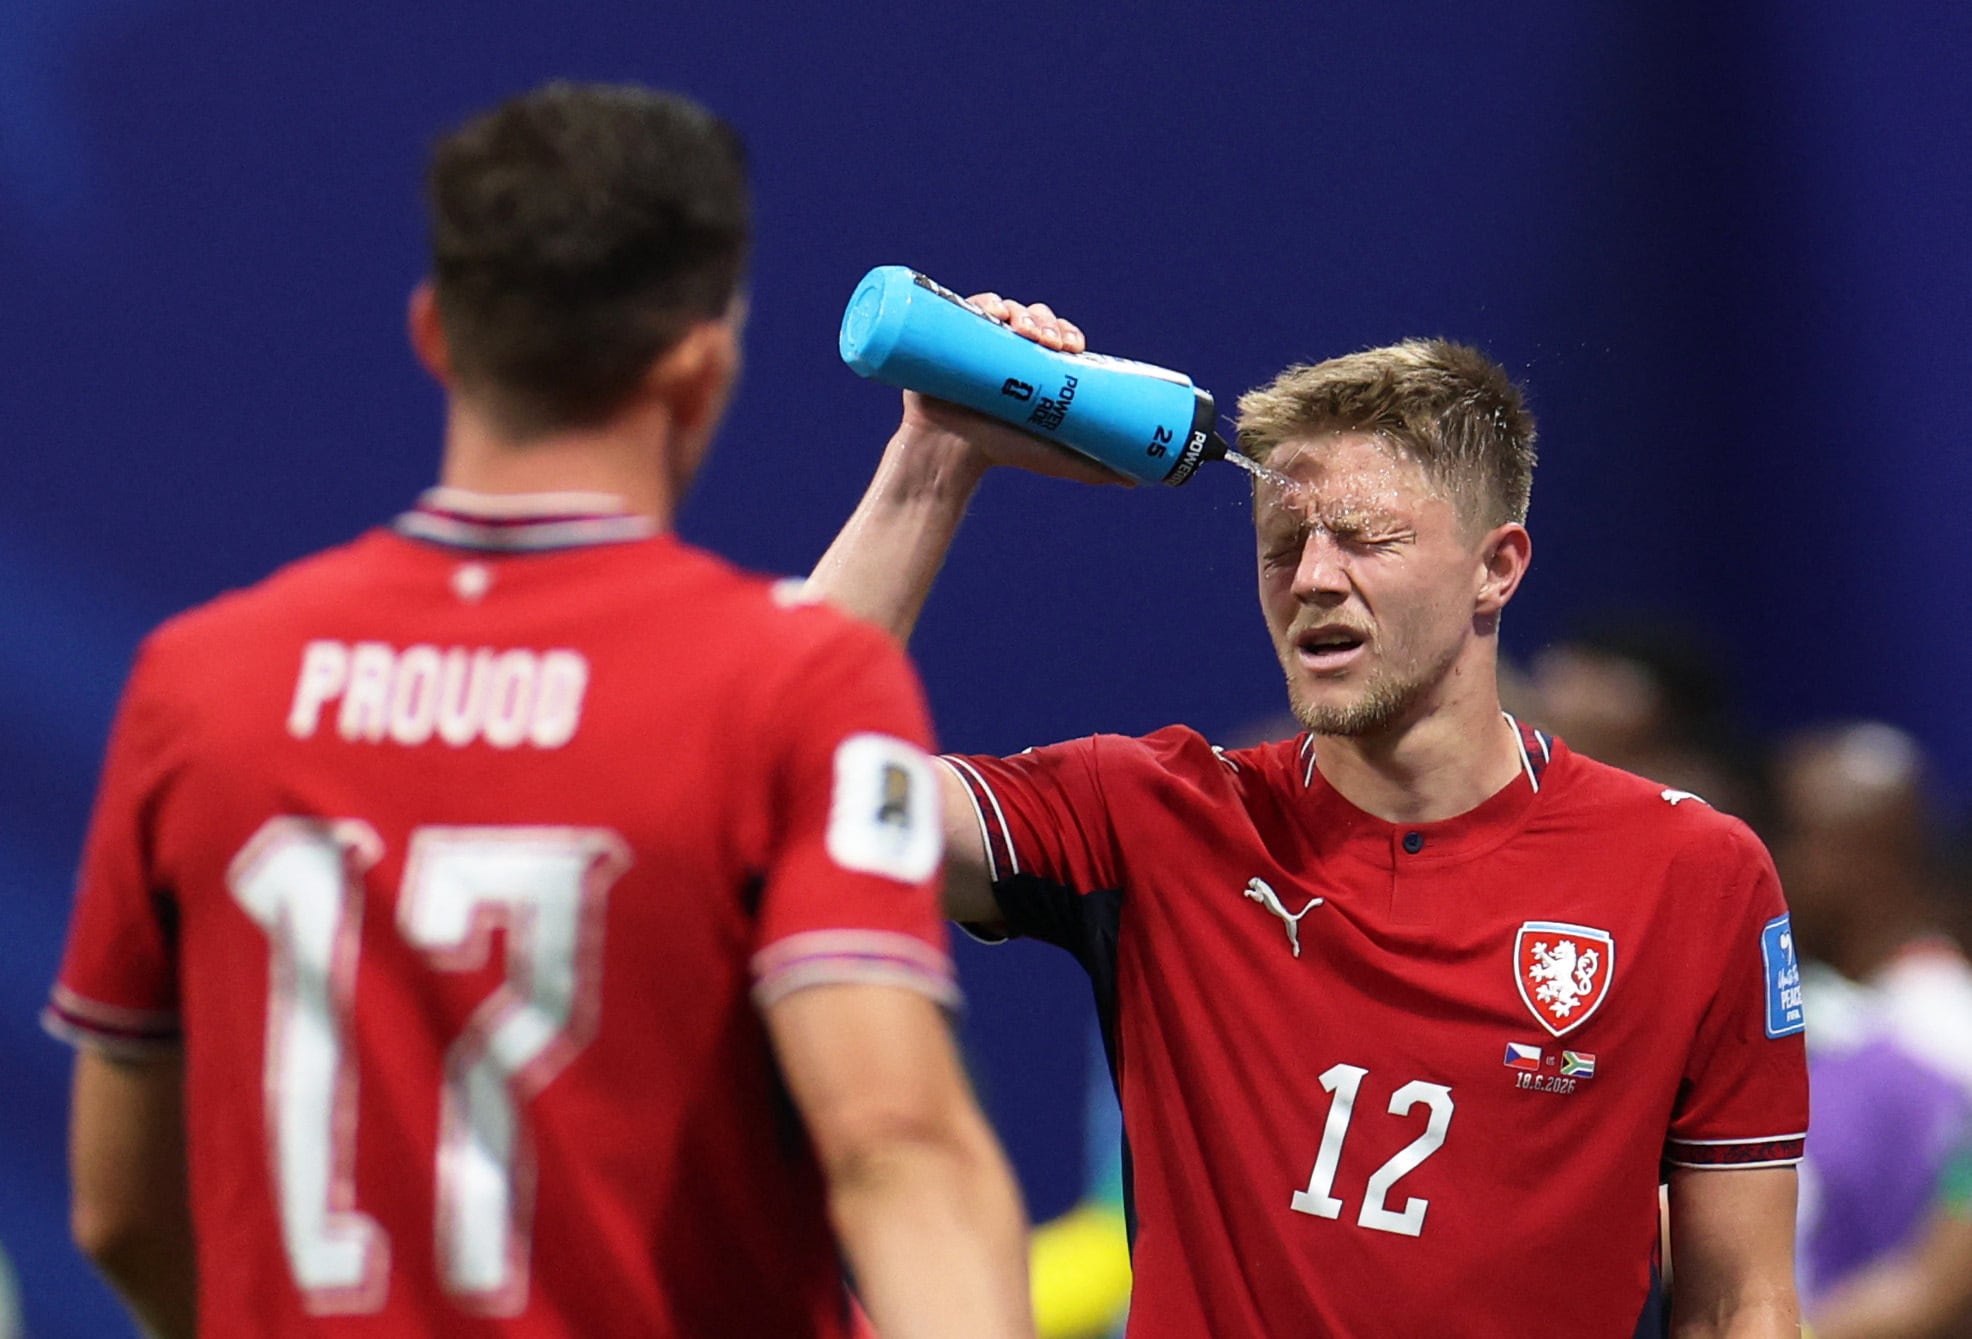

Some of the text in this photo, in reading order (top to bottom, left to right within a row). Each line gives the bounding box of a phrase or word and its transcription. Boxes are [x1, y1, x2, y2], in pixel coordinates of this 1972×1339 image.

[1044, 374, 1079, 431] POWER
[1146, 424, 1173, 459] 25
[226, 814, 634, 1318] 17
[1515, 1071, 1576, 1094] 18.6.2026
[1290, 1063, 1455, 1237] 12
